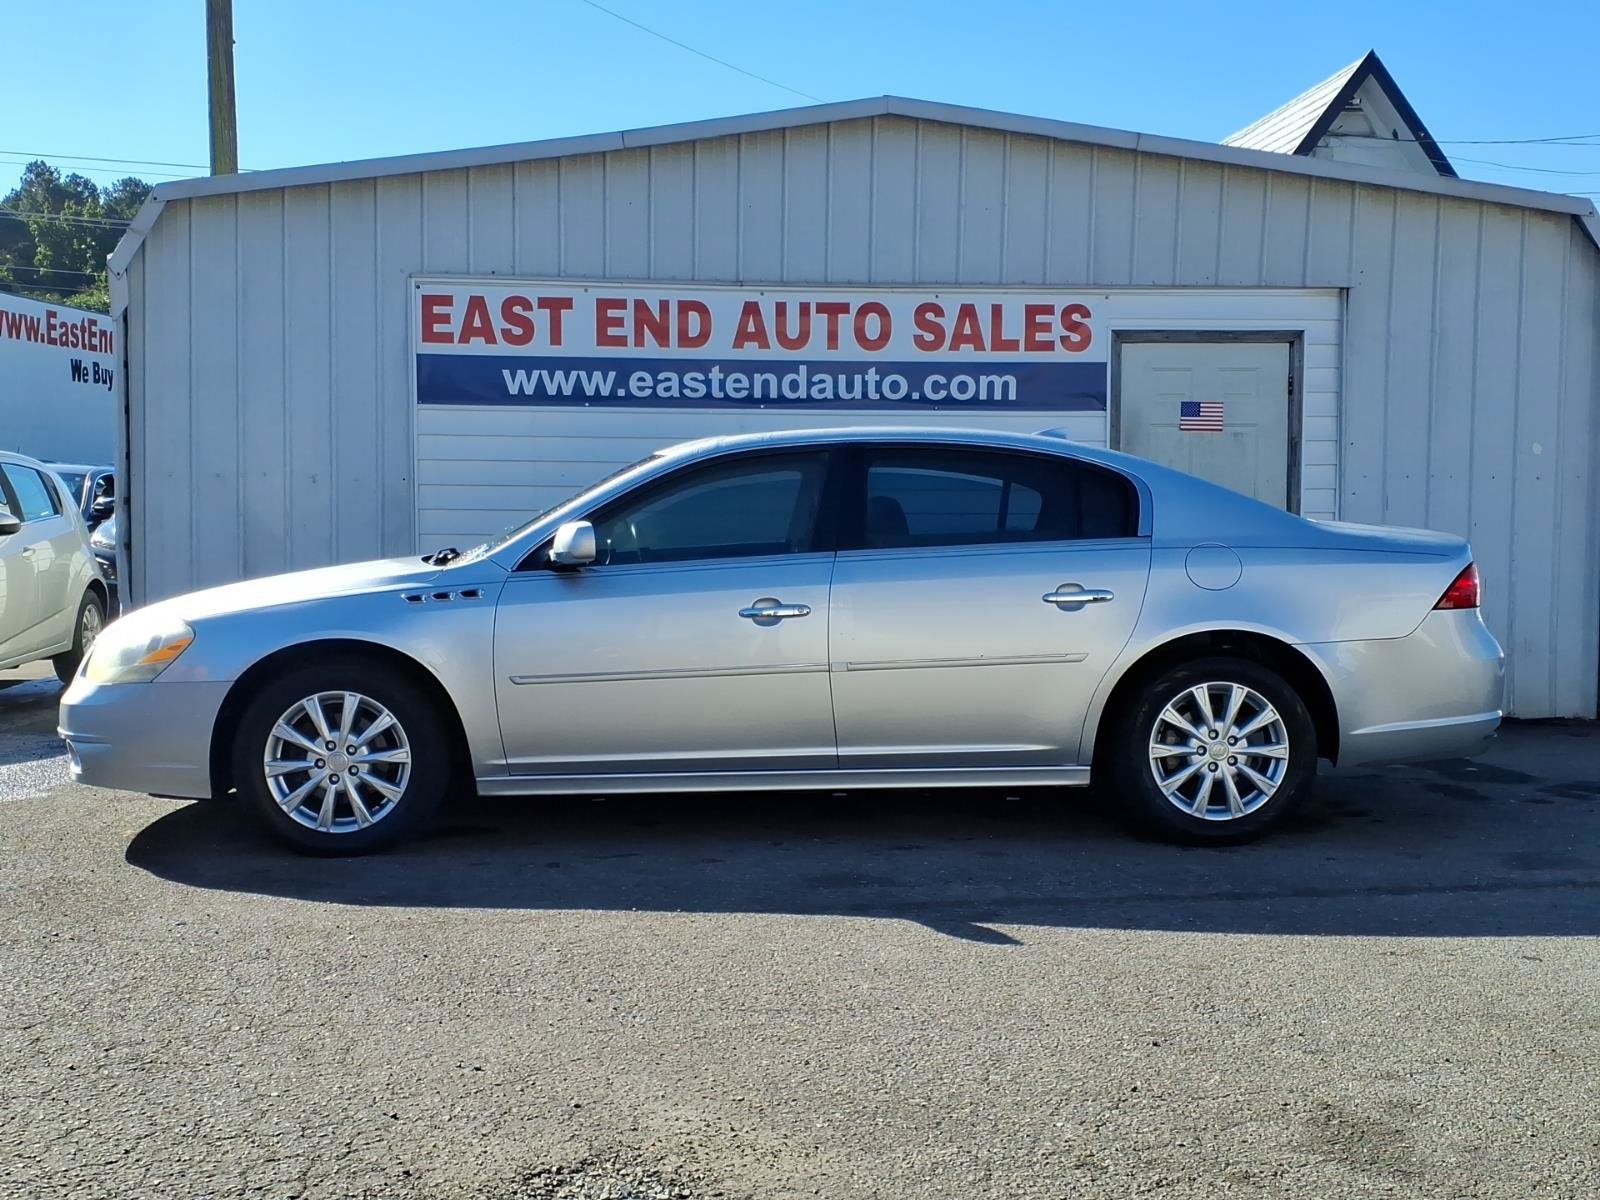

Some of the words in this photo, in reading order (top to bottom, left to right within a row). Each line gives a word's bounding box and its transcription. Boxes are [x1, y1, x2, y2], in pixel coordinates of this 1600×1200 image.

[0, 309, 113, 355] ww.EastEn
[421, 294, 573, 346] EAST
[595, 298, 713, 349] END
[731, 300, 892, 351] AUTO
[912, 302, 1092, 353] SALES
[70, 358, 89, 384] We
[92, 361, 113, 392] Buy
[501, 364, 1017, 401] www.eastendauto.com
